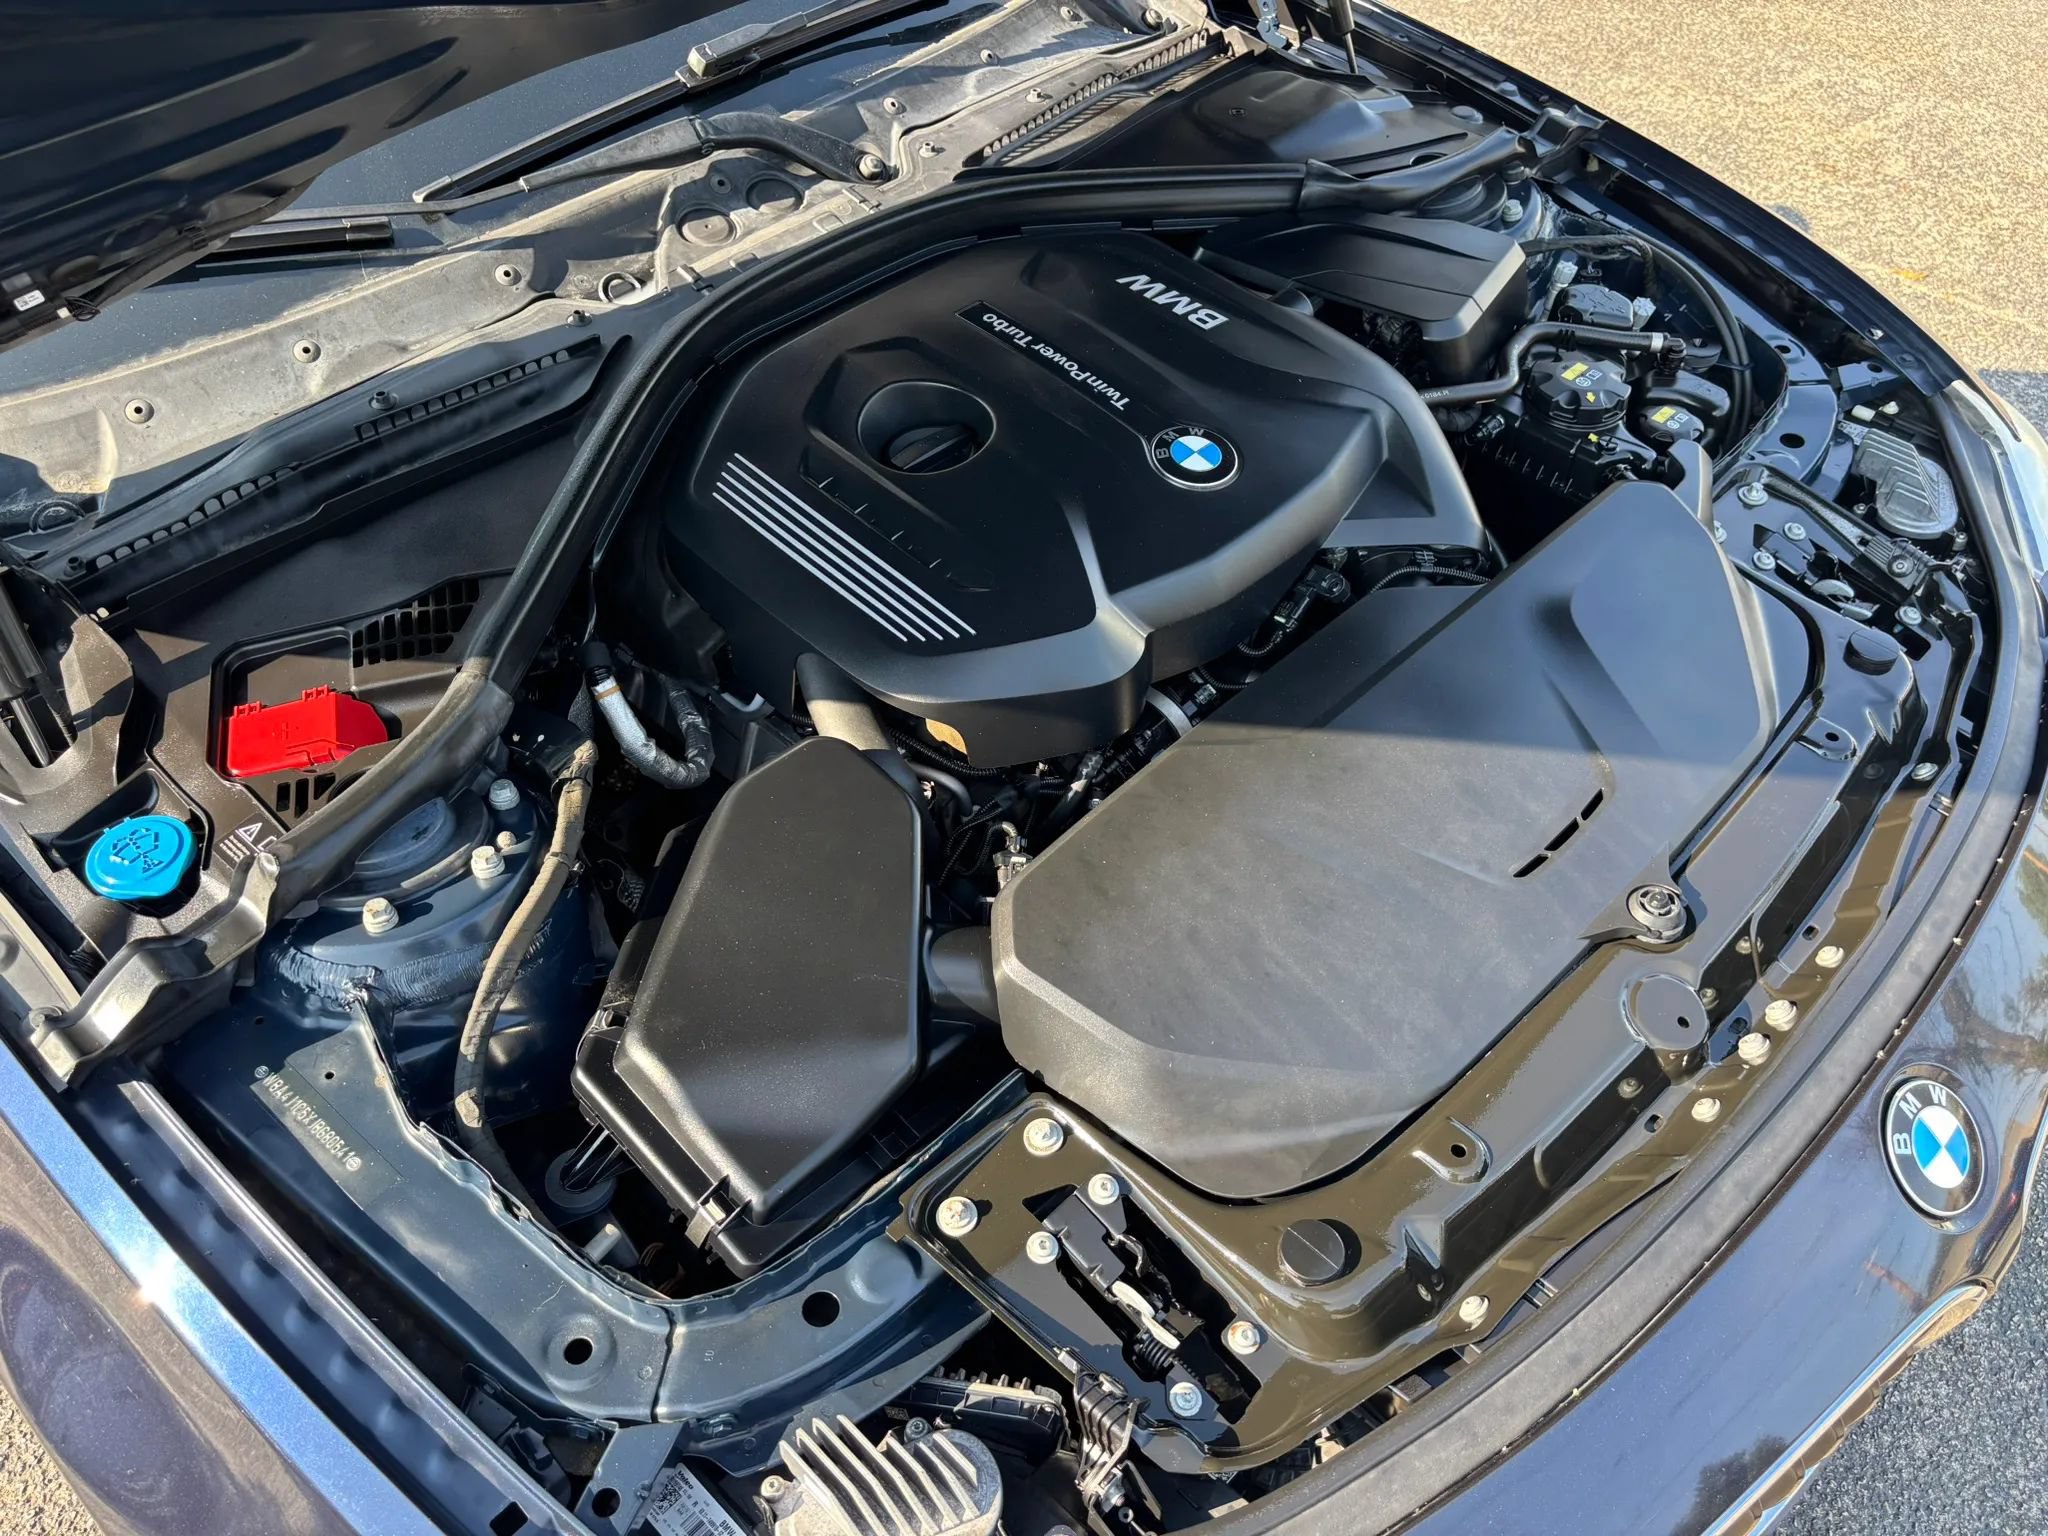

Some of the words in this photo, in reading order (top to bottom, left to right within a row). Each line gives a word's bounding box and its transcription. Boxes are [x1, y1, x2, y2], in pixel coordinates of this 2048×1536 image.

[1115, 274, 1229, 330] BMW
[982, 313, 1033, 347] Turbo
[1033, 342, 1130, 410] TwinPower
[1156, 427, 1204, 459] BMW
[1893, 1084, 1947, 1155] BMW
[678, 1470, 694, 1490] Valeo
[719, 1519, 737, 1536] BMW
